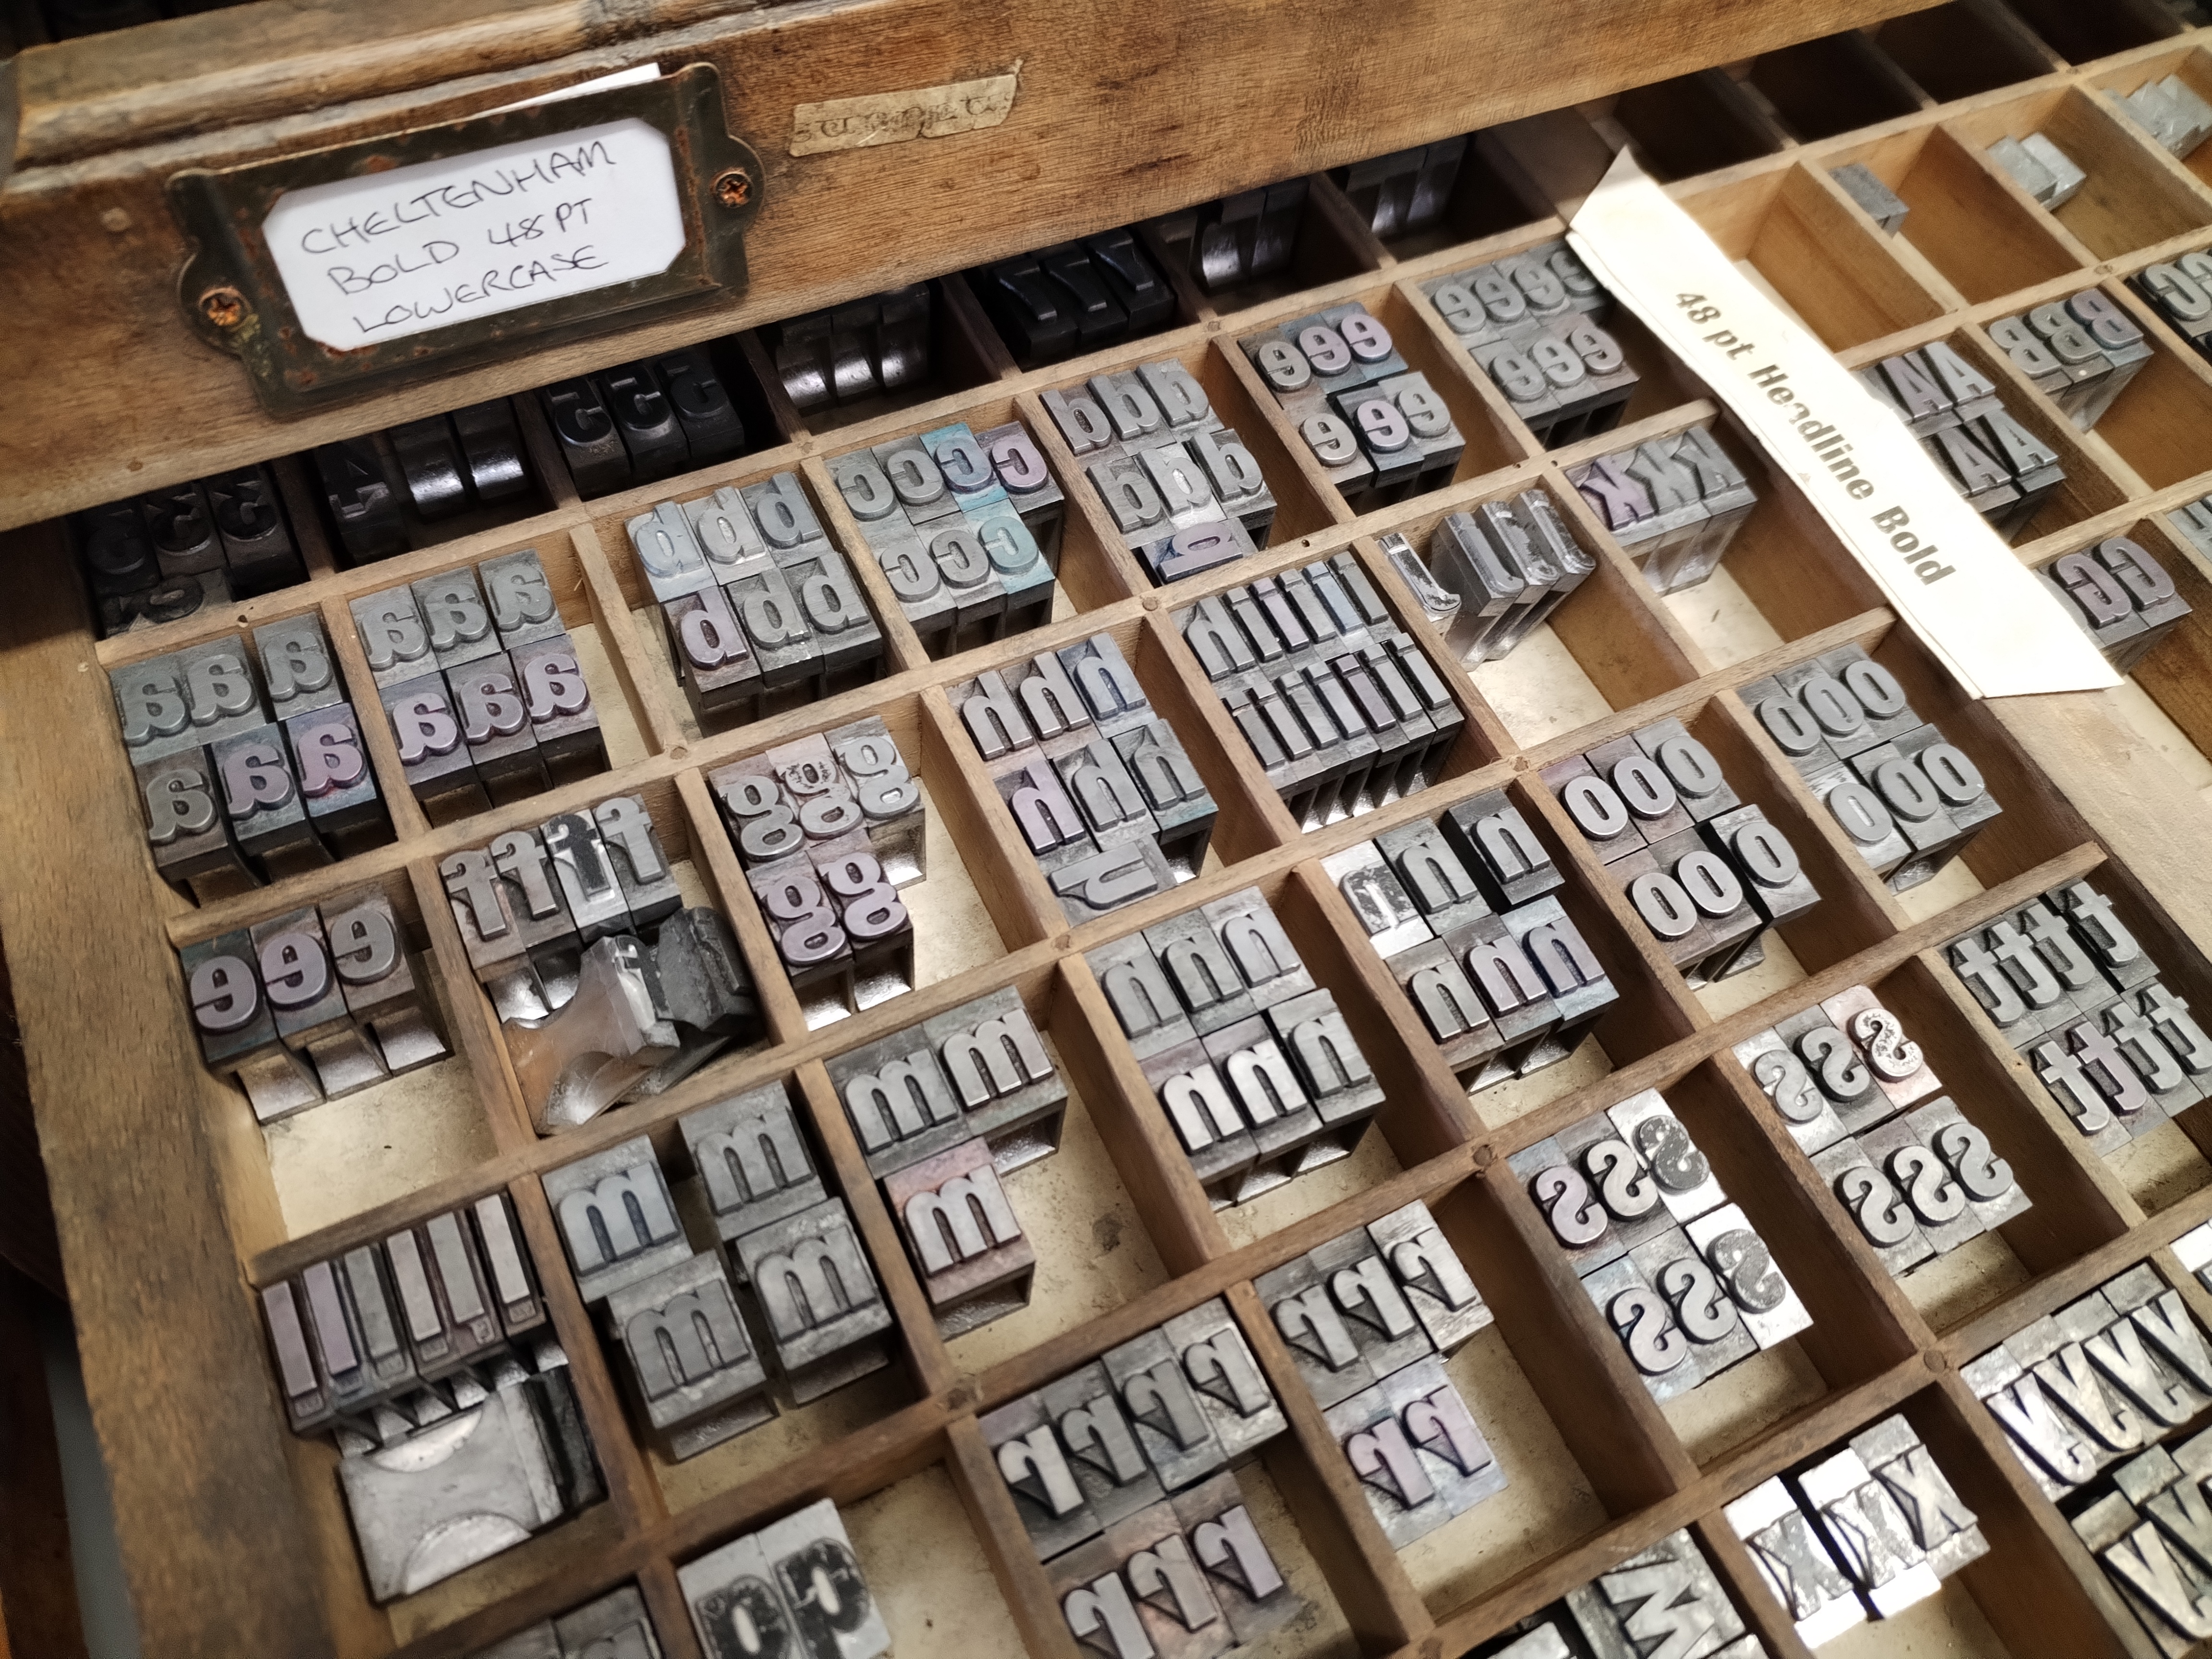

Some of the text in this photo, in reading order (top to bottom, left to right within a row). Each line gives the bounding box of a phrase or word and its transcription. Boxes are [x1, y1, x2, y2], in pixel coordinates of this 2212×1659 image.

[301, 140, 616, 254] CHELTENHAM
[327, 240, 459, 295] BOLD
[353, 245, 610, 333] LOWERCASE
[1675, 292, 1957, 586] 48 pt Headline Bold
